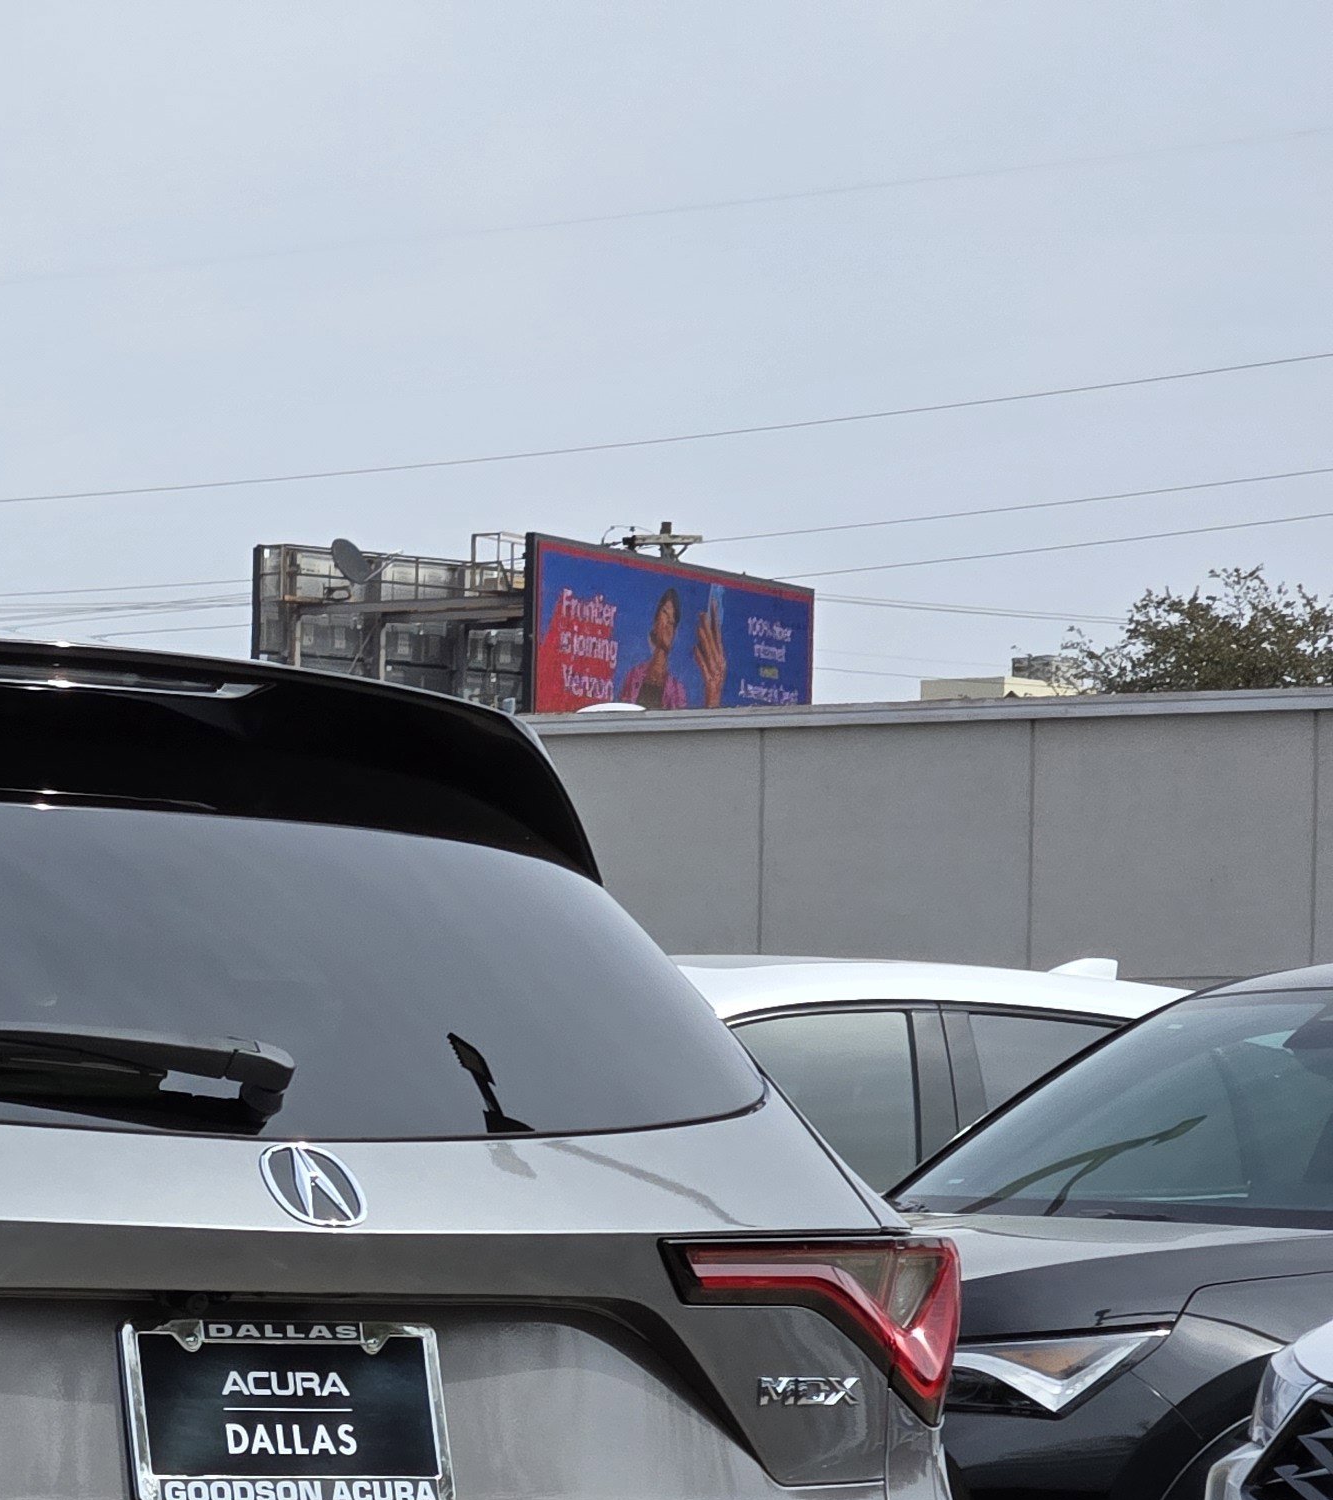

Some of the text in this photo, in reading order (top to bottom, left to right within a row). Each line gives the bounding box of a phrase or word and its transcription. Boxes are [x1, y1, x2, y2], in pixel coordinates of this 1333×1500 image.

[562, 589, 617, 627] Frontier
[572, 625, 619, 669] joining
[561, 663, 614, 701] Verizon
[208, 1323, 358, 1340] DALLAS
[221, 1371, 351, 1397] ACURA
[757, 1376, 861, 1406] MDX
[224, 1422, 358, 1456] DALLAS
